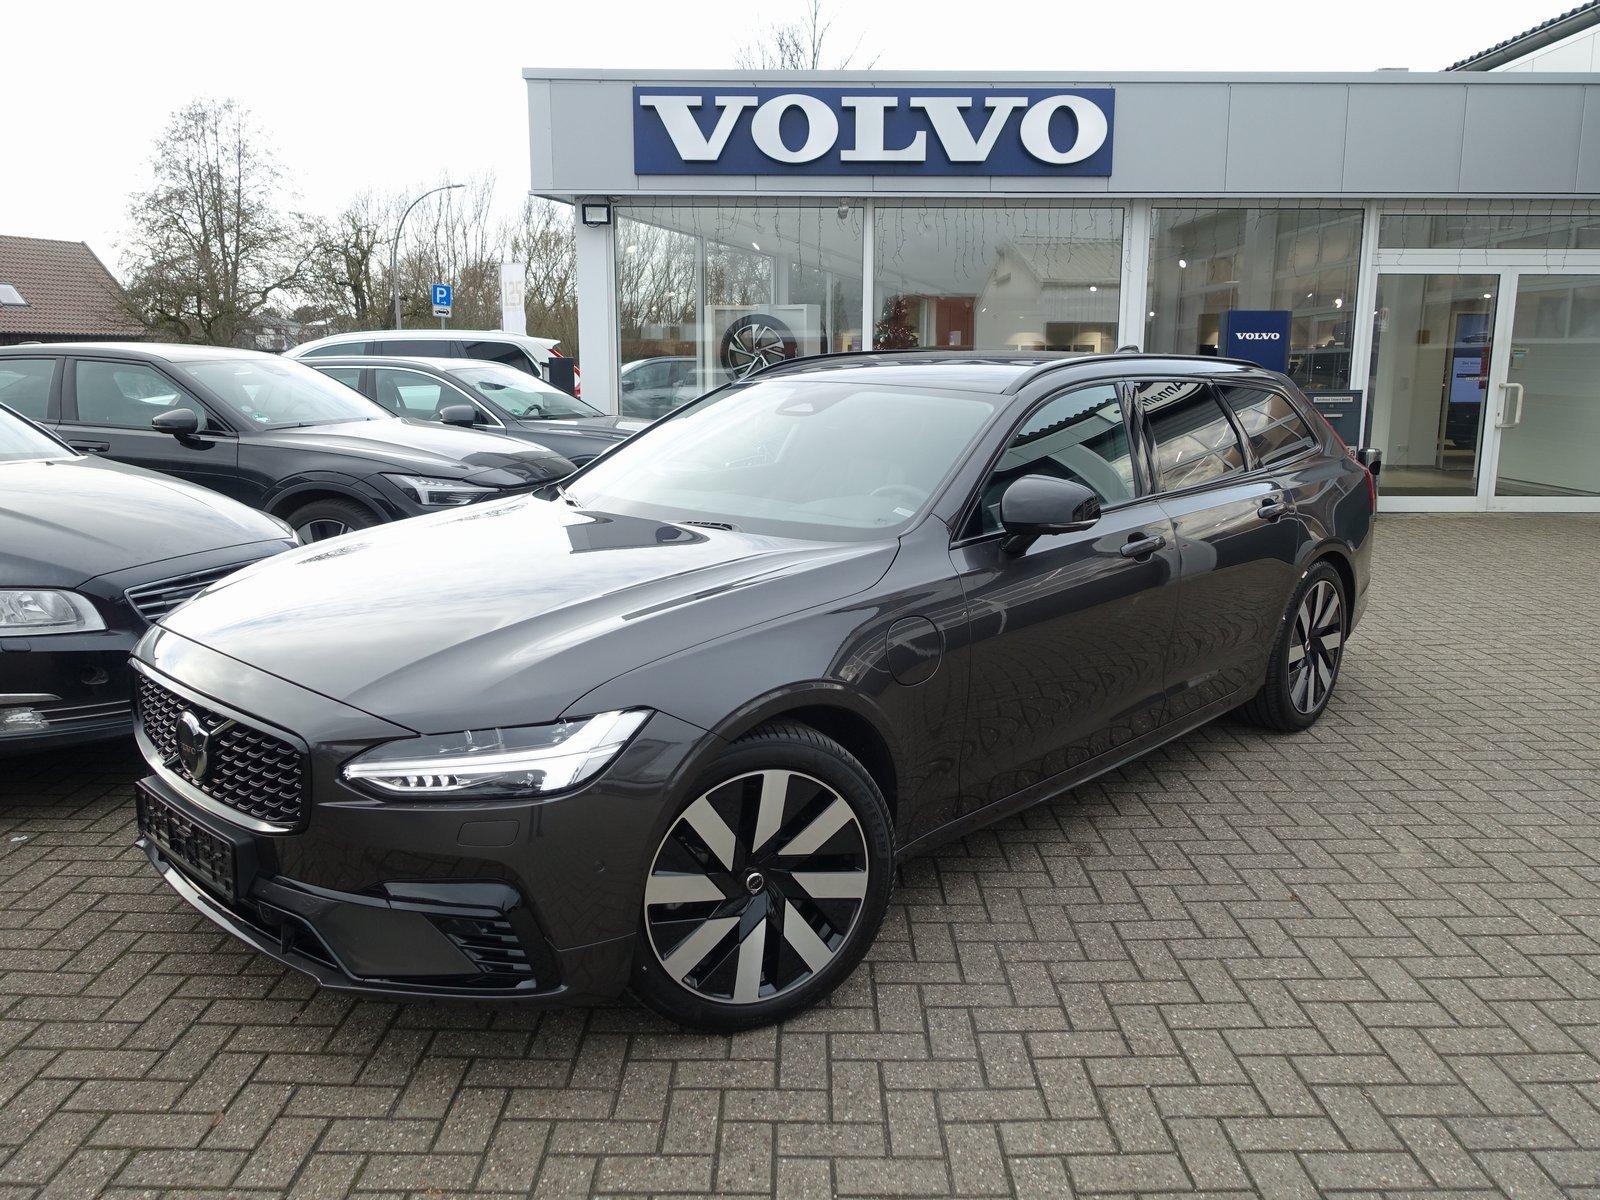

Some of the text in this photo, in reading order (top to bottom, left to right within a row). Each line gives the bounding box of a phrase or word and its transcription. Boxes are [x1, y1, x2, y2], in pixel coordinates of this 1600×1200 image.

[639, 93, 1108, 165] VOLVO
[436, 286, 447, 303] P
[1235, 332, 1280, 340] VOLVO
